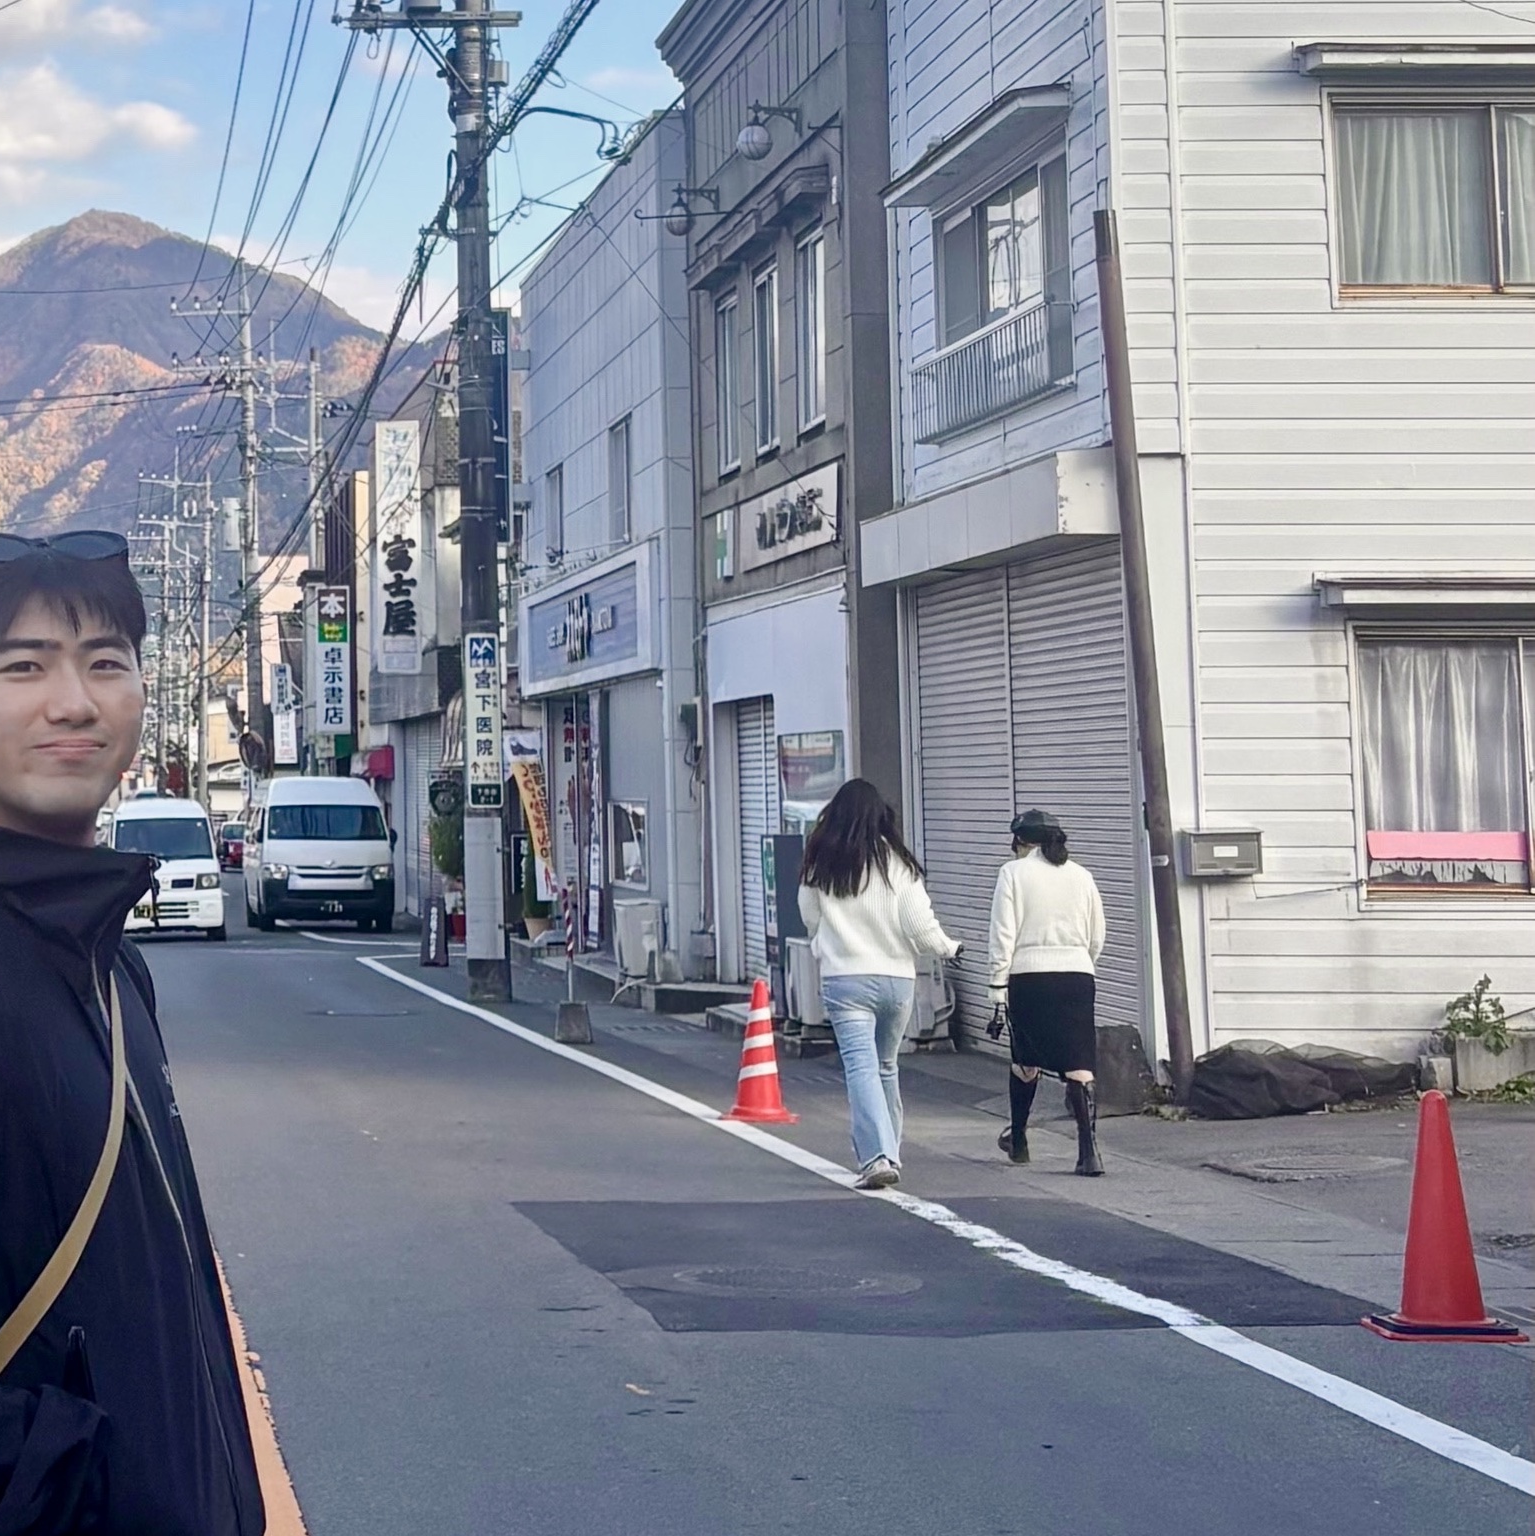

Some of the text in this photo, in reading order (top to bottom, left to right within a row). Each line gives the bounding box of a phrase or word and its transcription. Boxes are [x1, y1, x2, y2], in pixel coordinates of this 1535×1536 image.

[320, 592, 345, 618] 本
[474, 668, 494, 757] 宮下医院
